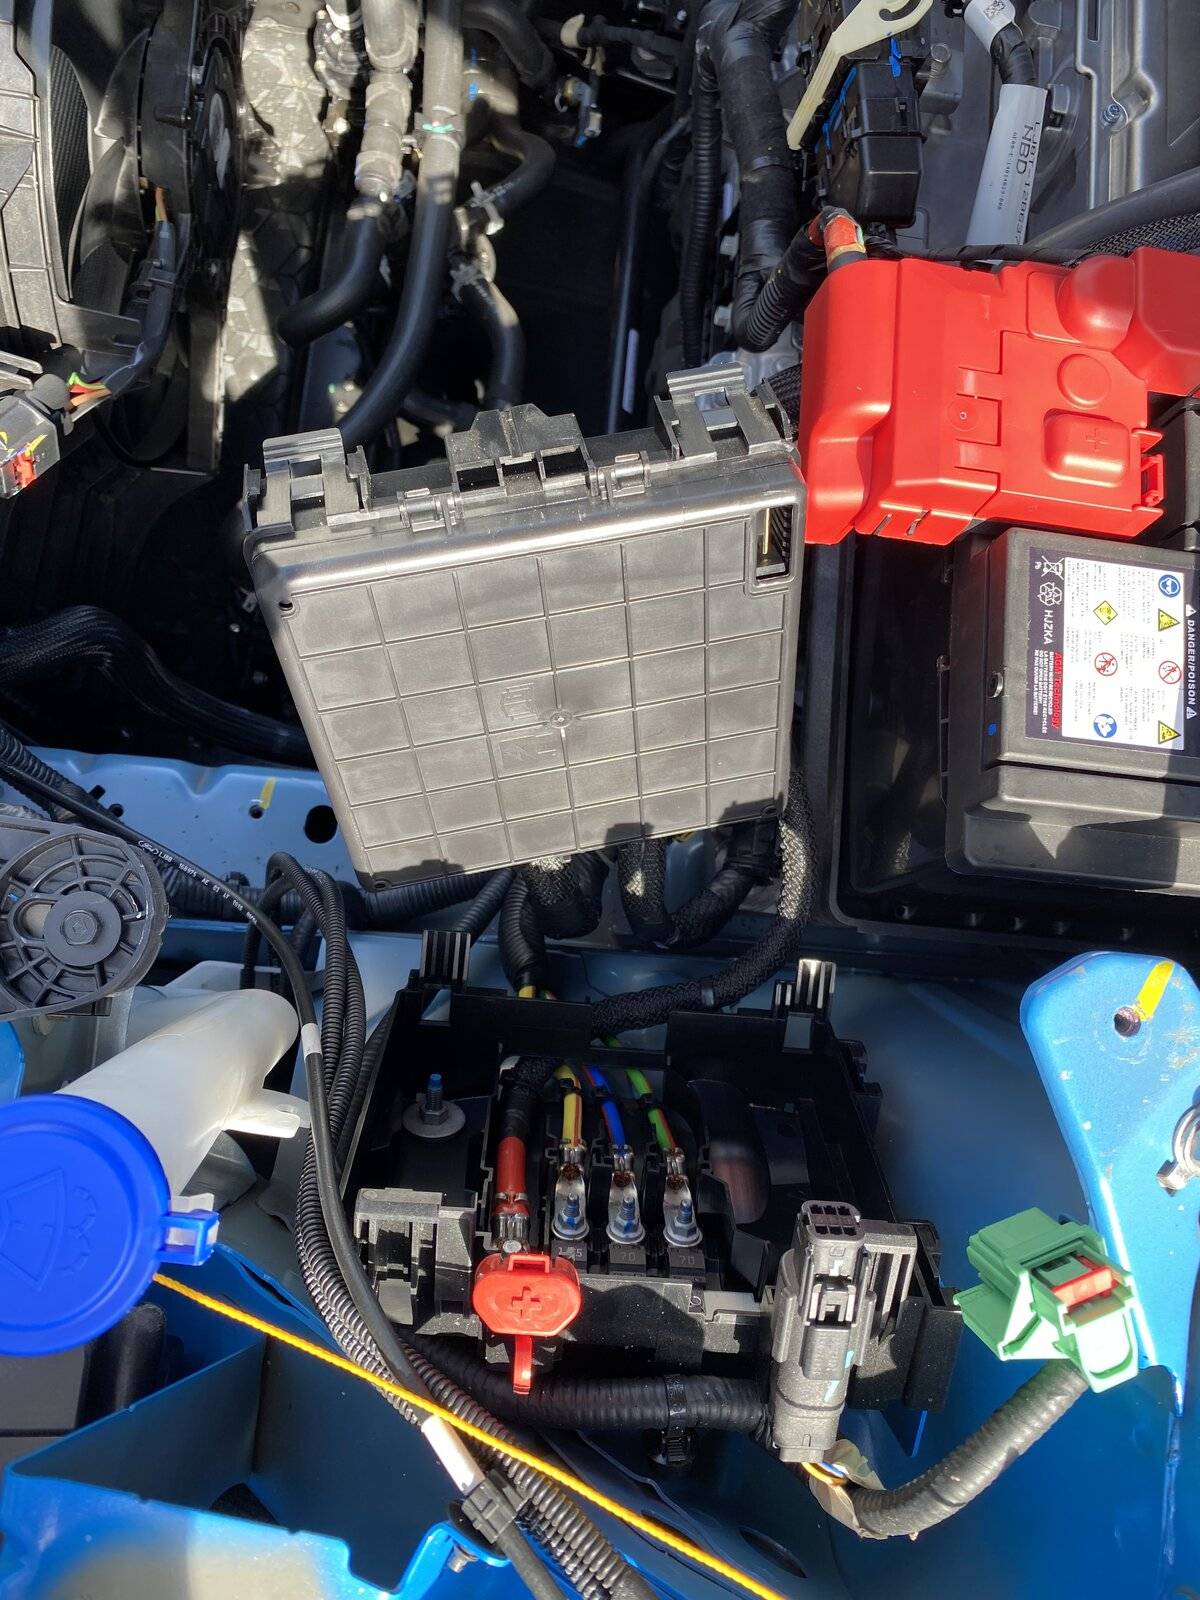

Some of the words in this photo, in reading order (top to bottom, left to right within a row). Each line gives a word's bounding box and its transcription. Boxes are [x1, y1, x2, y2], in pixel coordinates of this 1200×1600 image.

[1016, 124, 1034, 174] NBD
[1034, 561, 1042, 570] Pb
[1043, 609, 1054, 645] HJZKA
[1054, 652, 1062, 673] AGM
[1187, 620, 1196, 705] DANGER/POISON
[1052, 678, 1062, 729] Technology
[558, 1246, 582, 1258] 15
[620, 1252, 636, 1261] 70
[679, 1255, 695, 1265] 70
